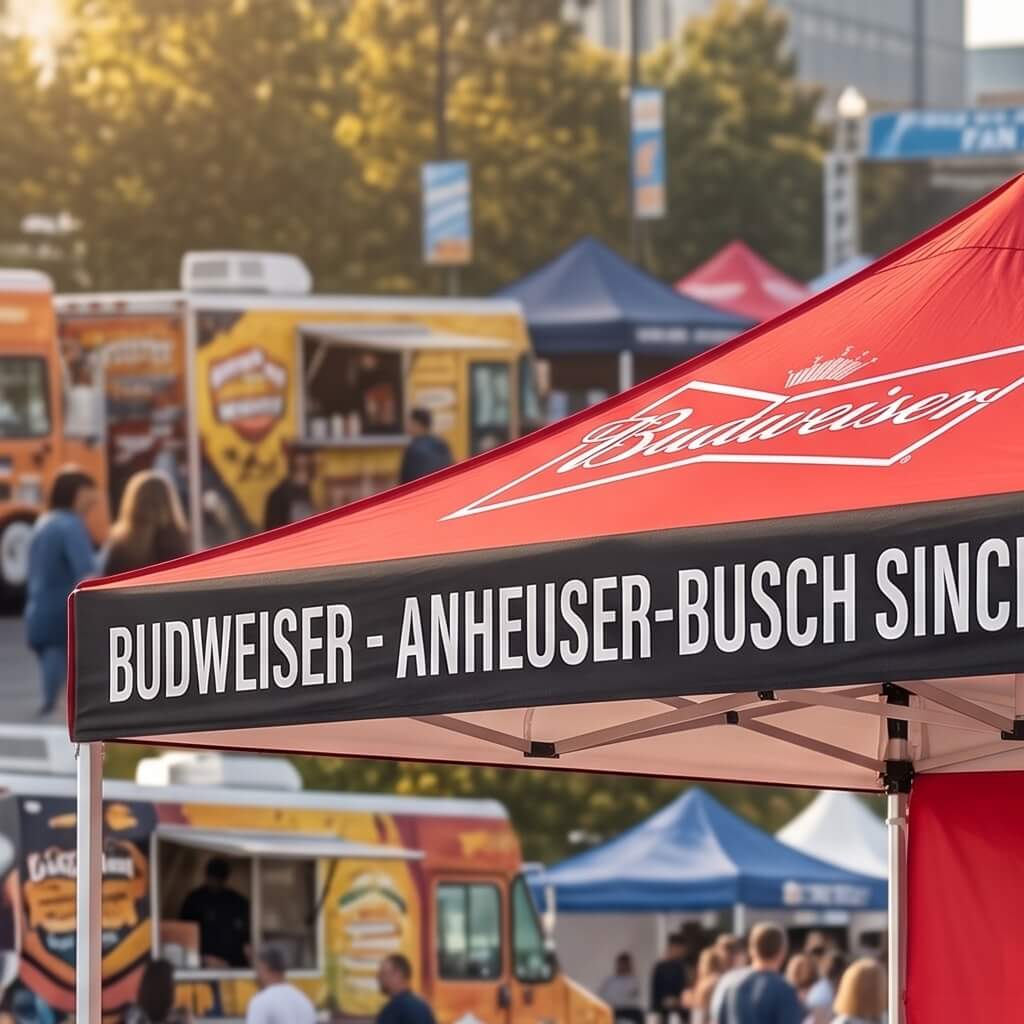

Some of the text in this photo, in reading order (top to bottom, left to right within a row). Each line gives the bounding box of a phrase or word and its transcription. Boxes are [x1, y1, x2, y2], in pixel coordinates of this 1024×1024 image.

[557, 386, 1001, 473] Budweiser
[109, 603, 353, 703] BUDWEISER
[396, 553, 856, 679] ANHEUSER-BUSCH
